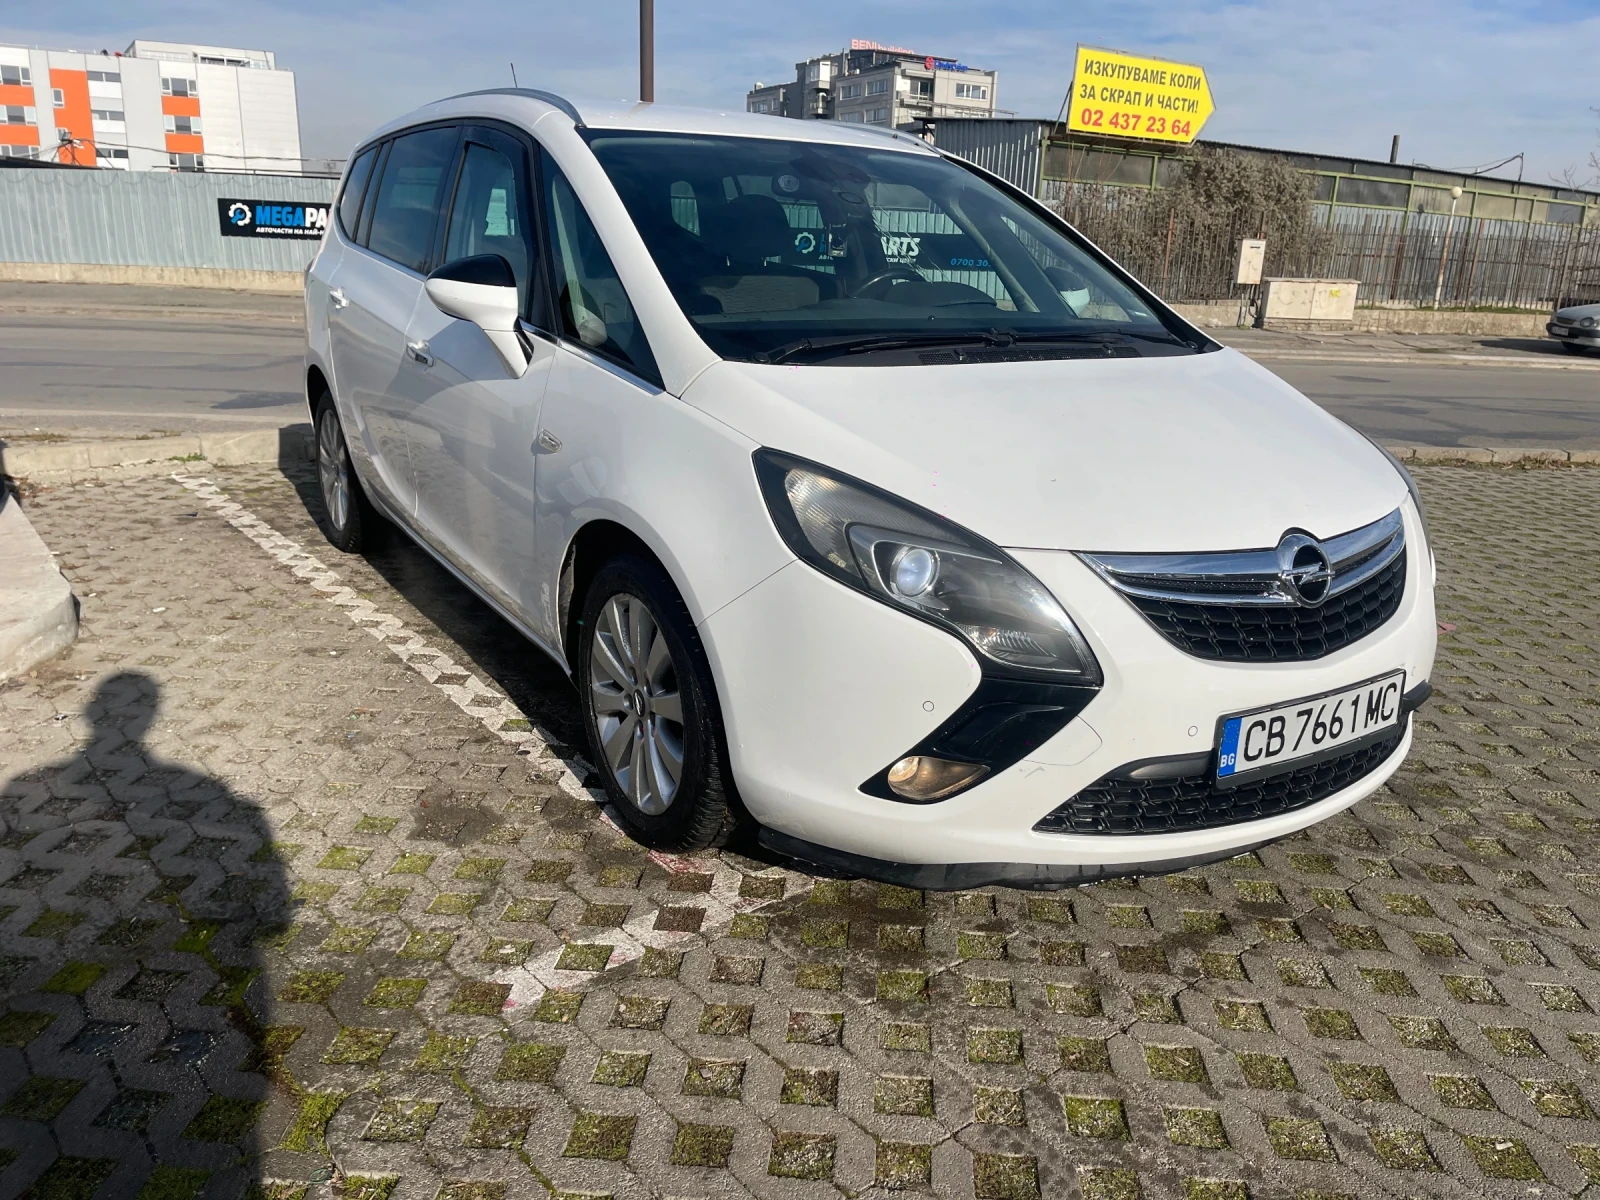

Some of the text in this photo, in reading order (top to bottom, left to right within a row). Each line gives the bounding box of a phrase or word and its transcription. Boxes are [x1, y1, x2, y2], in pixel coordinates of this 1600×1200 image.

[851, 38, 877, 50] BENI
[1084, 59, 1201, 91] ИЗКУПУВАМЕ КОЛИ
[1080, 84, 1199, 113] ЗА СКРАП И ЧАСТИ!
[1081, 108, 1191, 137] 02 437 23 64
[950, 258, 991, 267] 0700 30
[1292, 694, 1360, 752] 7661
[1220, 752, 1235, 767] BG
